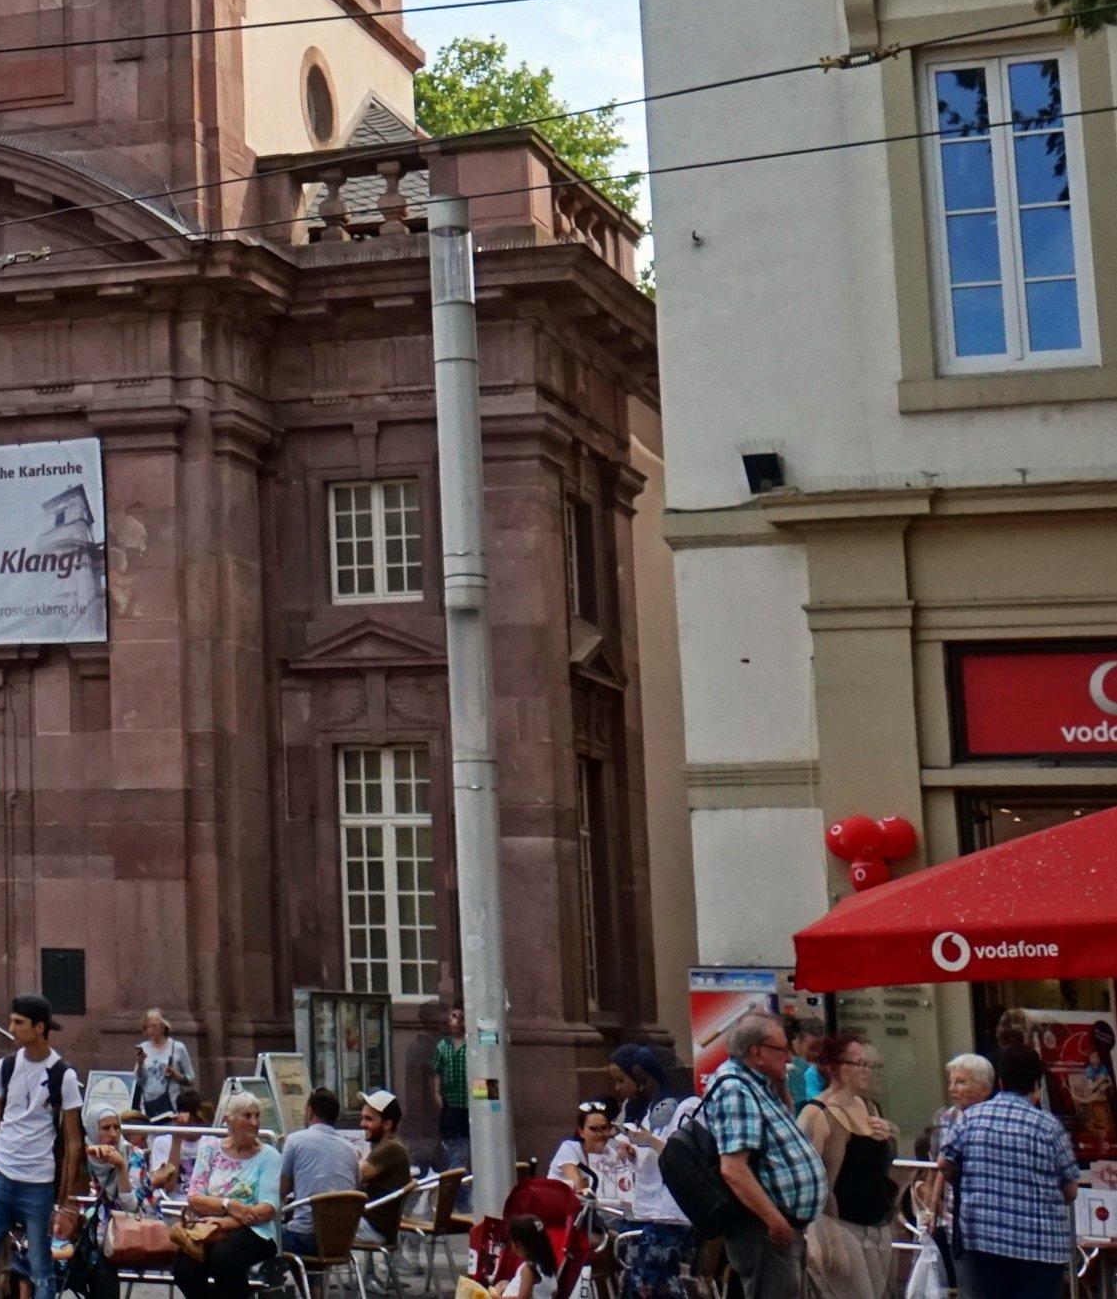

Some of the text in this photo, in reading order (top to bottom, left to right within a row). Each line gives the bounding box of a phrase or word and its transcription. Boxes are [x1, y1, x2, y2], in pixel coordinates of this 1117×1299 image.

[19, 461, 83, 478] Karlsruhe
[0, 547, 84, 579] Klang!
[974, 940, 1059, 959] vodafone
